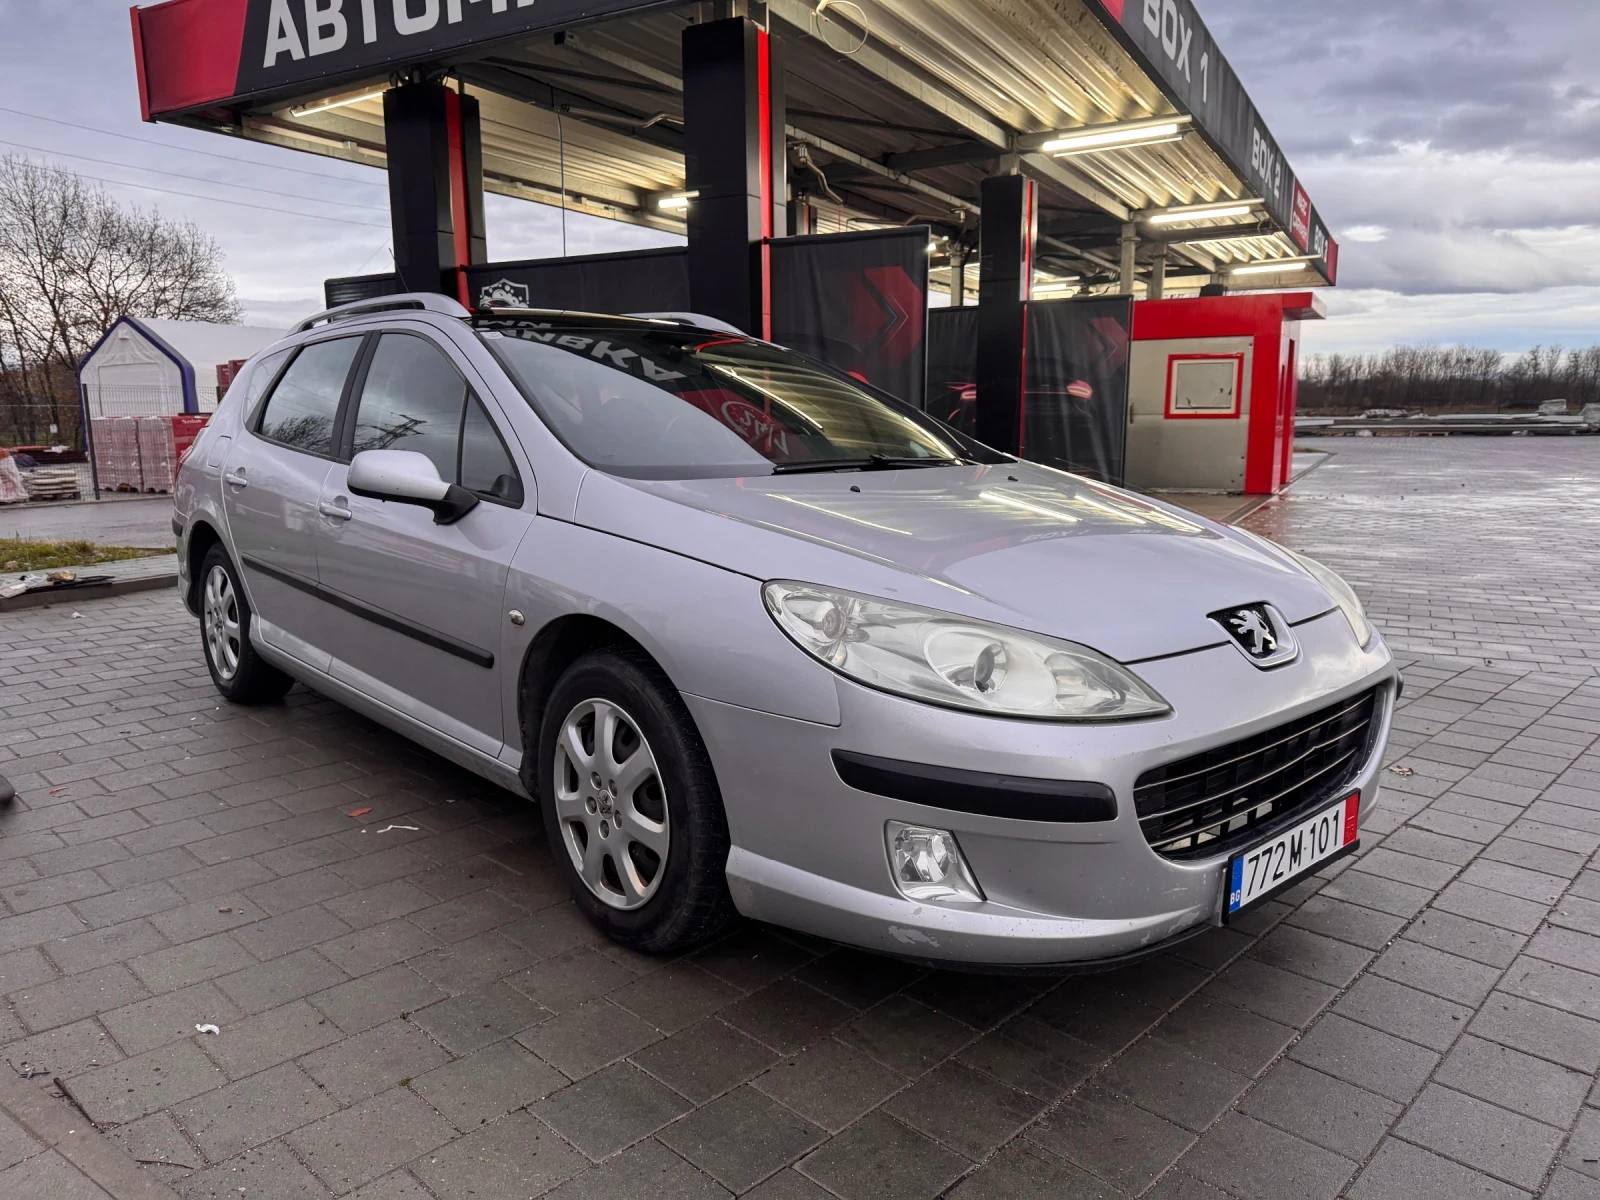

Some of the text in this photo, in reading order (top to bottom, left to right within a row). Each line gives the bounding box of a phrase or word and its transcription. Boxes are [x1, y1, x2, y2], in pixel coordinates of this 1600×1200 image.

[1143, 0, 1209, 104] BOX 1
[1251, 126, 1281, 199] BOX 2
[1230, 889, 1241, 905] BG
